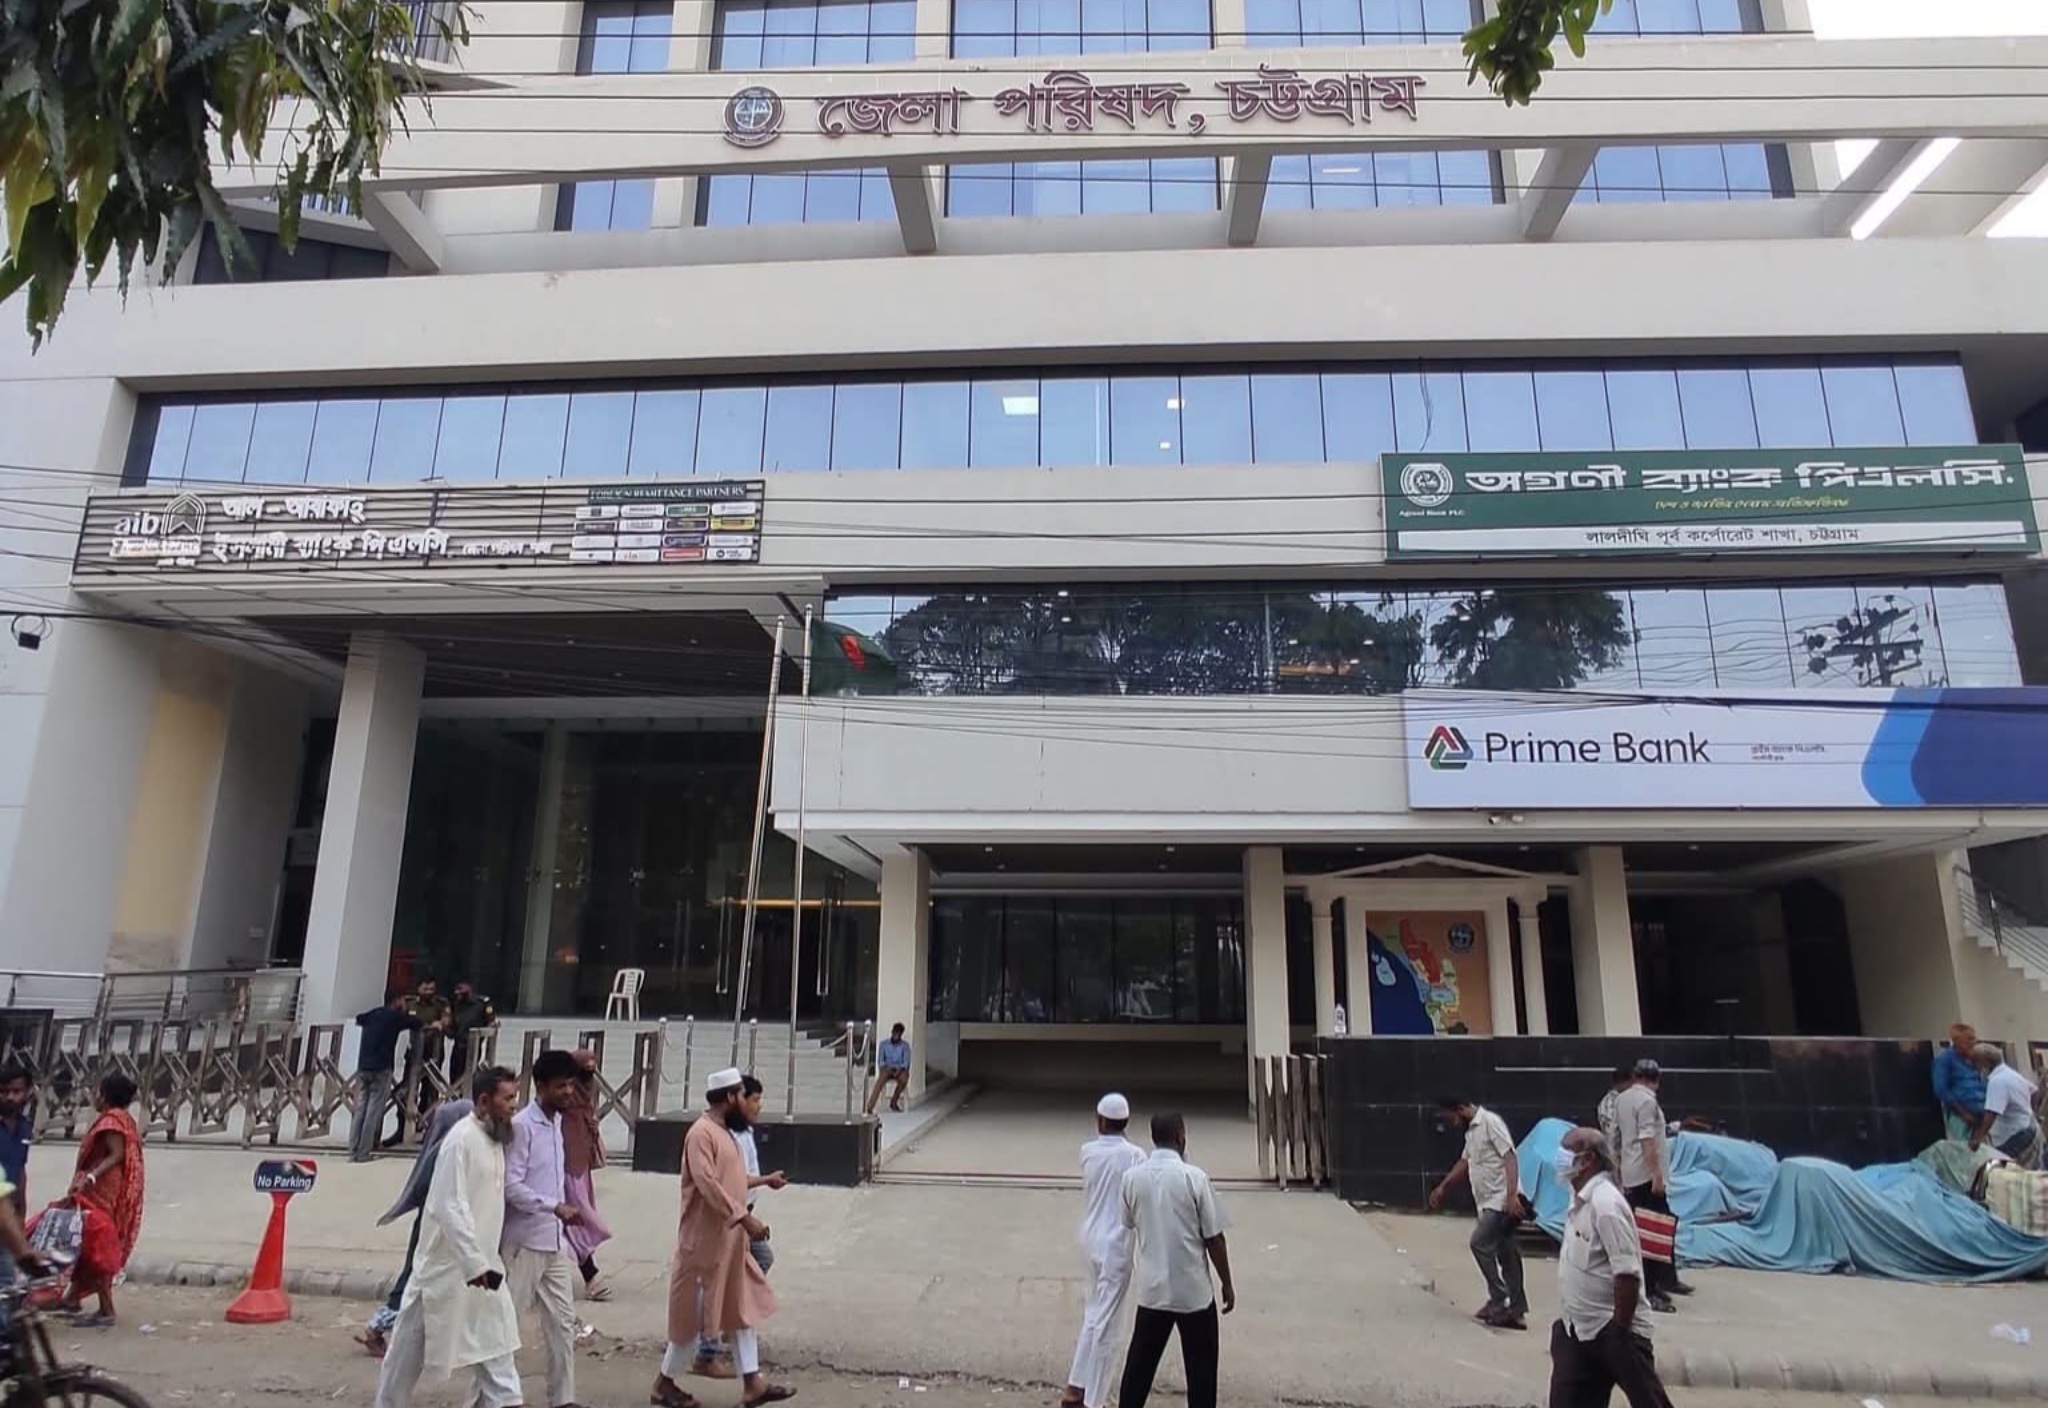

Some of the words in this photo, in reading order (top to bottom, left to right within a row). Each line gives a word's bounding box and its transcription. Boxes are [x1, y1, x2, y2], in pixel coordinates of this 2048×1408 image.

[815, 86, 968, 137] জেলা
[1214, 63, 1426, 126] চট্টগ্রাম
[1465, 464, 1627, 491] অগ্রণী
[1641, 468, 1782, 493] ব্যাংক
[1795, 459, 2014, 487] পিএলসি.
[115, 511, 160, 535] aib
[1656, 527, 1680, 545] পূর্ব
[1485, 732, 1600, 763] Prime
[1612, 731, 1711, 764] Bank
[257, 1175, 272, 1187] No
[274, 1175, 311, 1190] Parking
